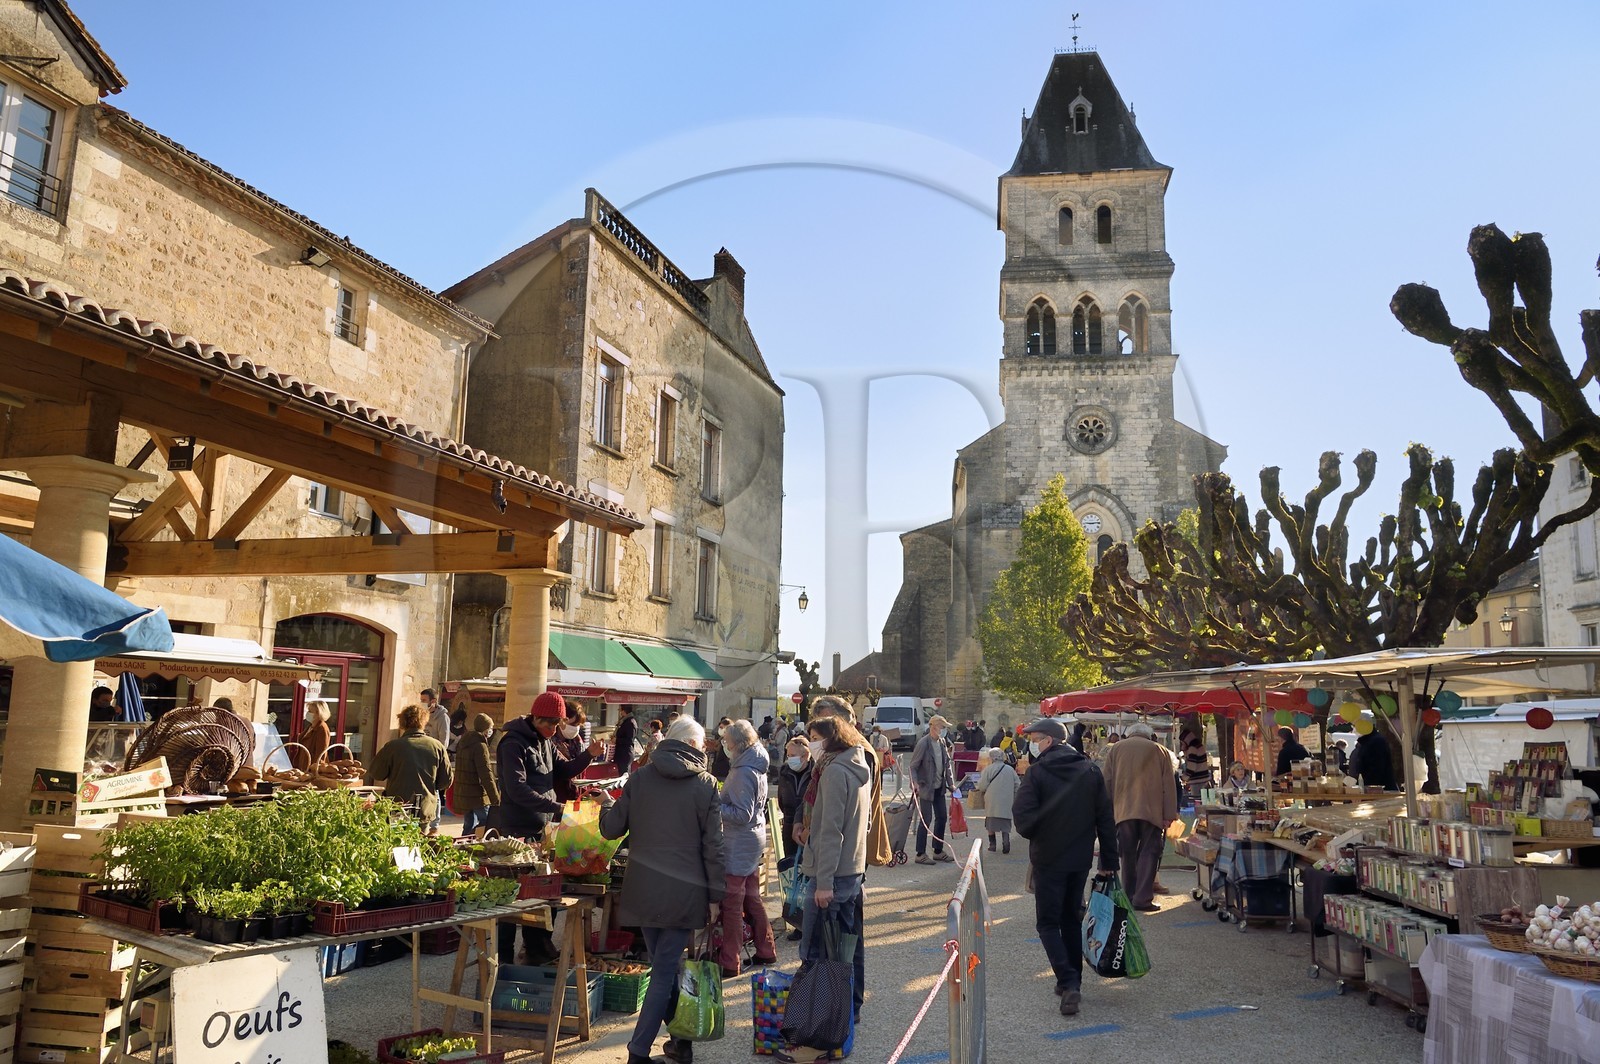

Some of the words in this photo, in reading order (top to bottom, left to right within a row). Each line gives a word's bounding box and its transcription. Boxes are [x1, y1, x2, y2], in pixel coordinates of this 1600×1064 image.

[95, 661, 122, 669] ertrand
[123, 662, 147, 670] SAGNE
[160, 662, 199, 672] Producteur
[200, 665, 209, 673] de
[210, 665, 235, 675] Canard
[235, 667, 251, 676] Gras
[260, 669, 268, 677] 05
[268, 670, 276, 678] 53
[283, 671, 290, 679] 42
[557, 687, 589, 695] Producteur
[107, 775, 143, 788] AGRUMINE
[202, 991, 303, 1049] Oeufs
